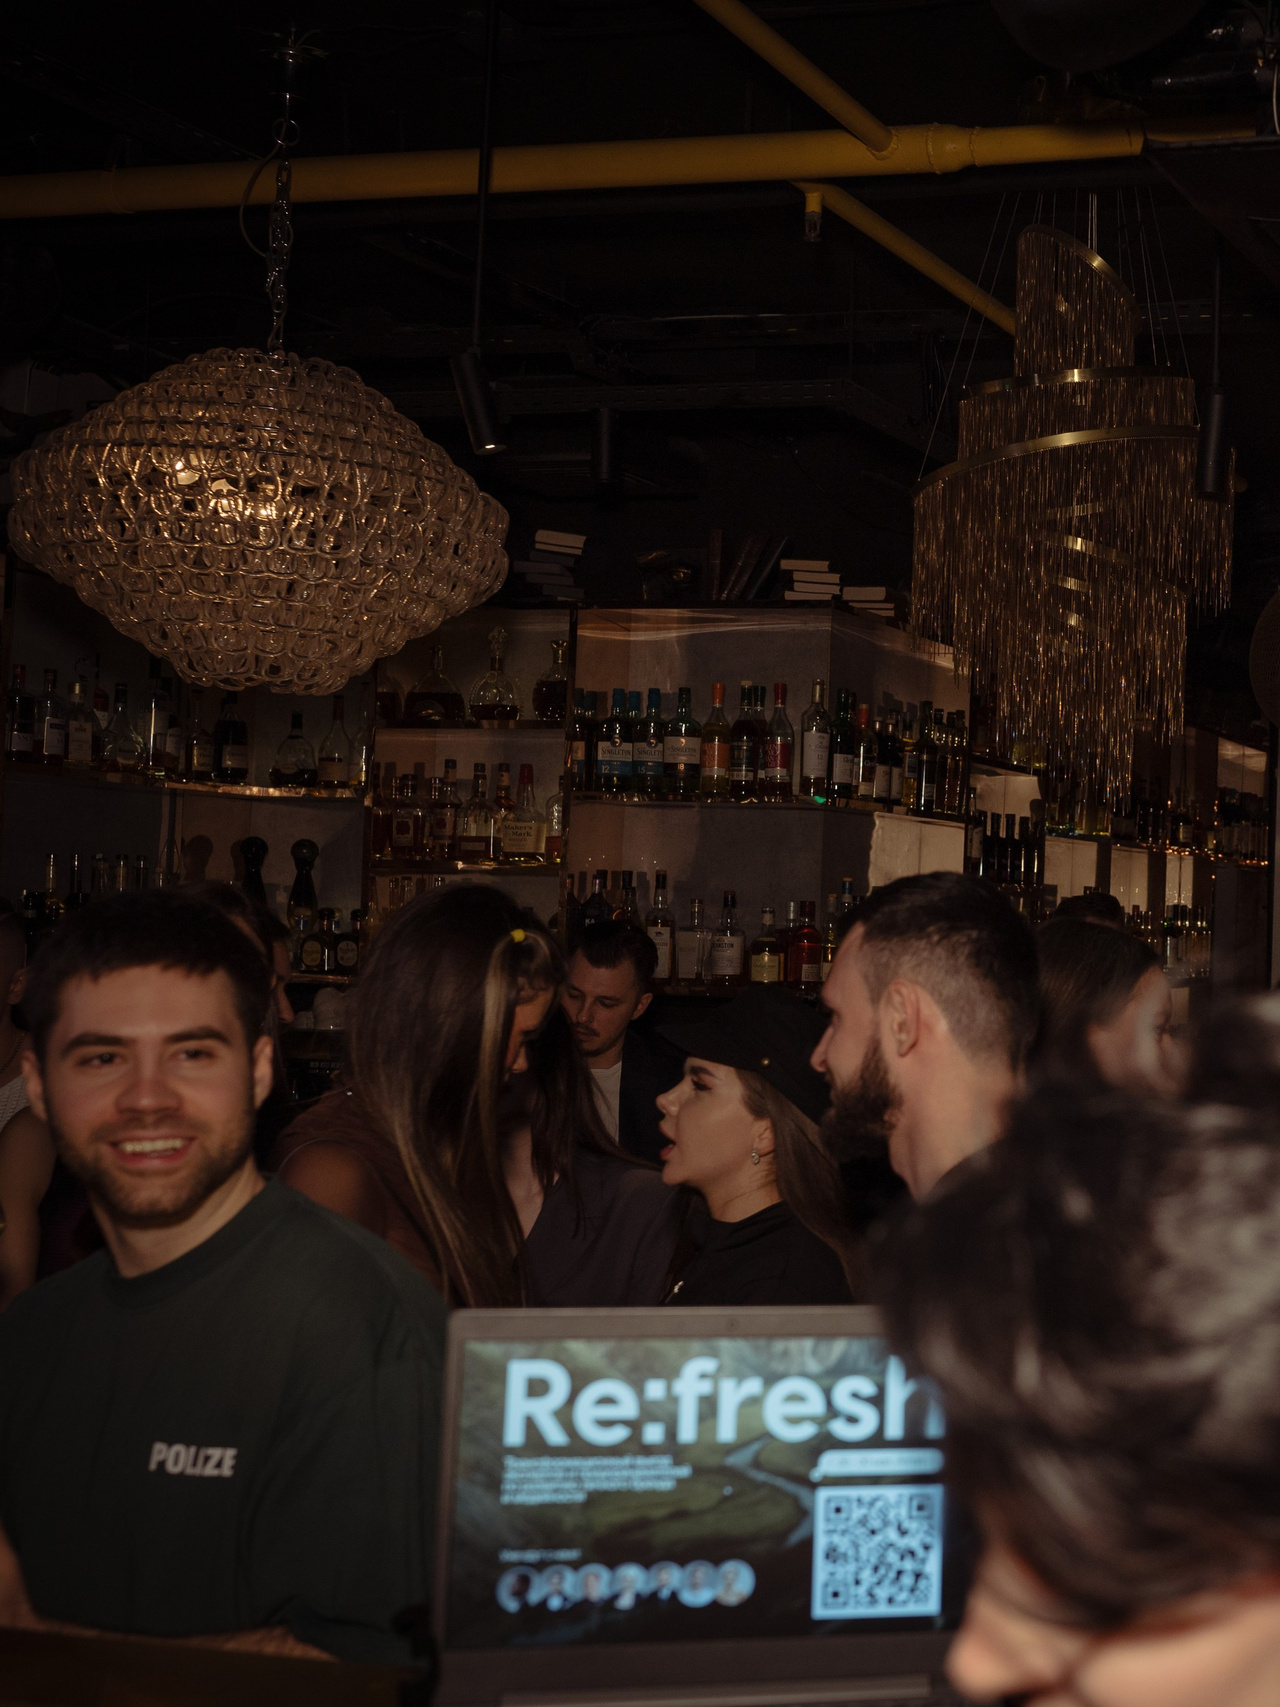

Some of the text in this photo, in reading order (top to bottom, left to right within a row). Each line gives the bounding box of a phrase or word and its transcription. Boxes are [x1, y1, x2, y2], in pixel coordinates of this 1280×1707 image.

[637, 747, 663, 756] SINGLET
[602, 765, 610, 773] 12
[503, 1356, 946, 1448] Re:fresh
